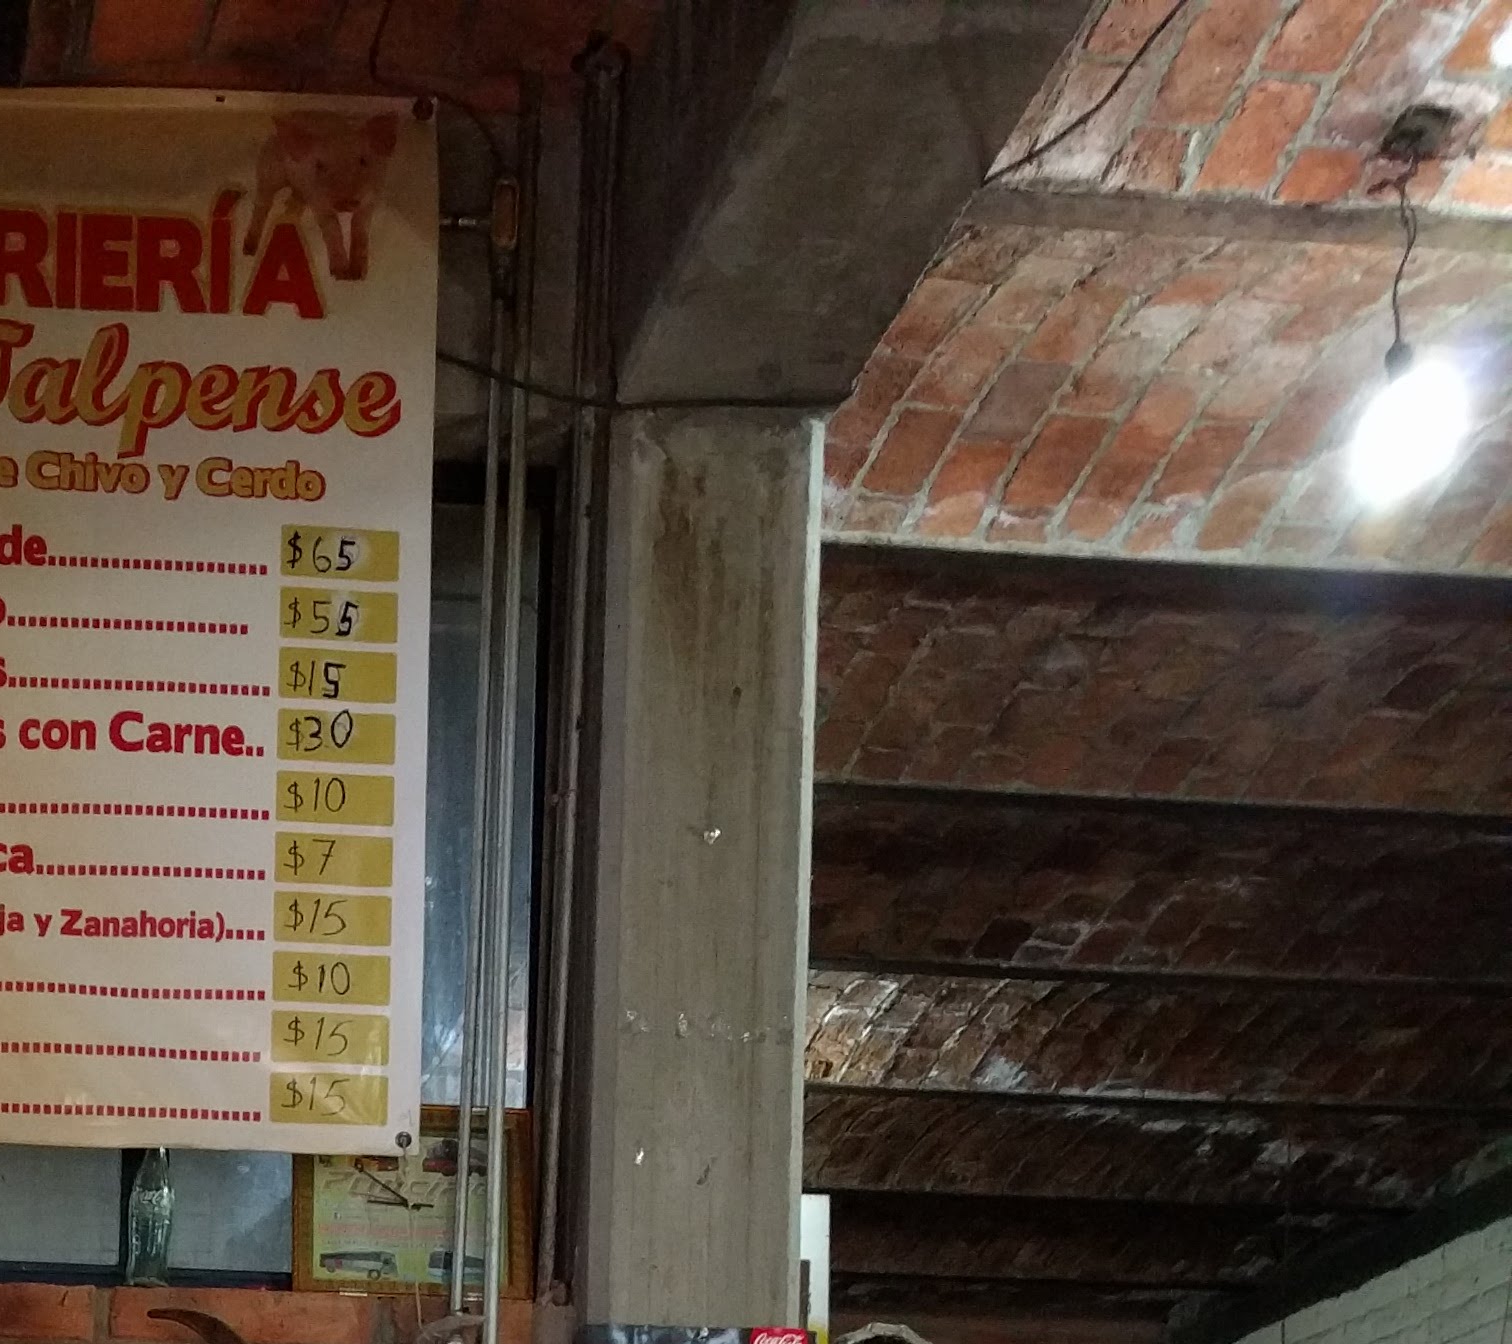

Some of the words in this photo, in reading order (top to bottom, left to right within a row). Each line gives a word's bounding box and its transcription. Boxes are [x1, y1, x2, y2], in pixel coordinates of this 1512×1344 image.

[25, 450, 149, 495] Chivo
[158, 463, 188, 500] y
[195, 457, 327, 501] Cerdo
[286, 530, 356, 574] $65
[284, 597, 359, 637] $55
[286, 660, 347, 699] $15
[18, 717, 97, 751] con
[108, 710, 245, 757] Carne
[286, 709, 353, 752] $30
[284, 777, 346, 813] $10
[283, 838, 336, 876] $7
[36, 912, 52, 938] y
[60, 908, 227, 943] Zanahoria)
[284, 898, 349, 936] $15
[288, 959, 350, 996] $10
[283, 1016, 353, 1057] $15
[281, 1075, 351, 1117] $15
